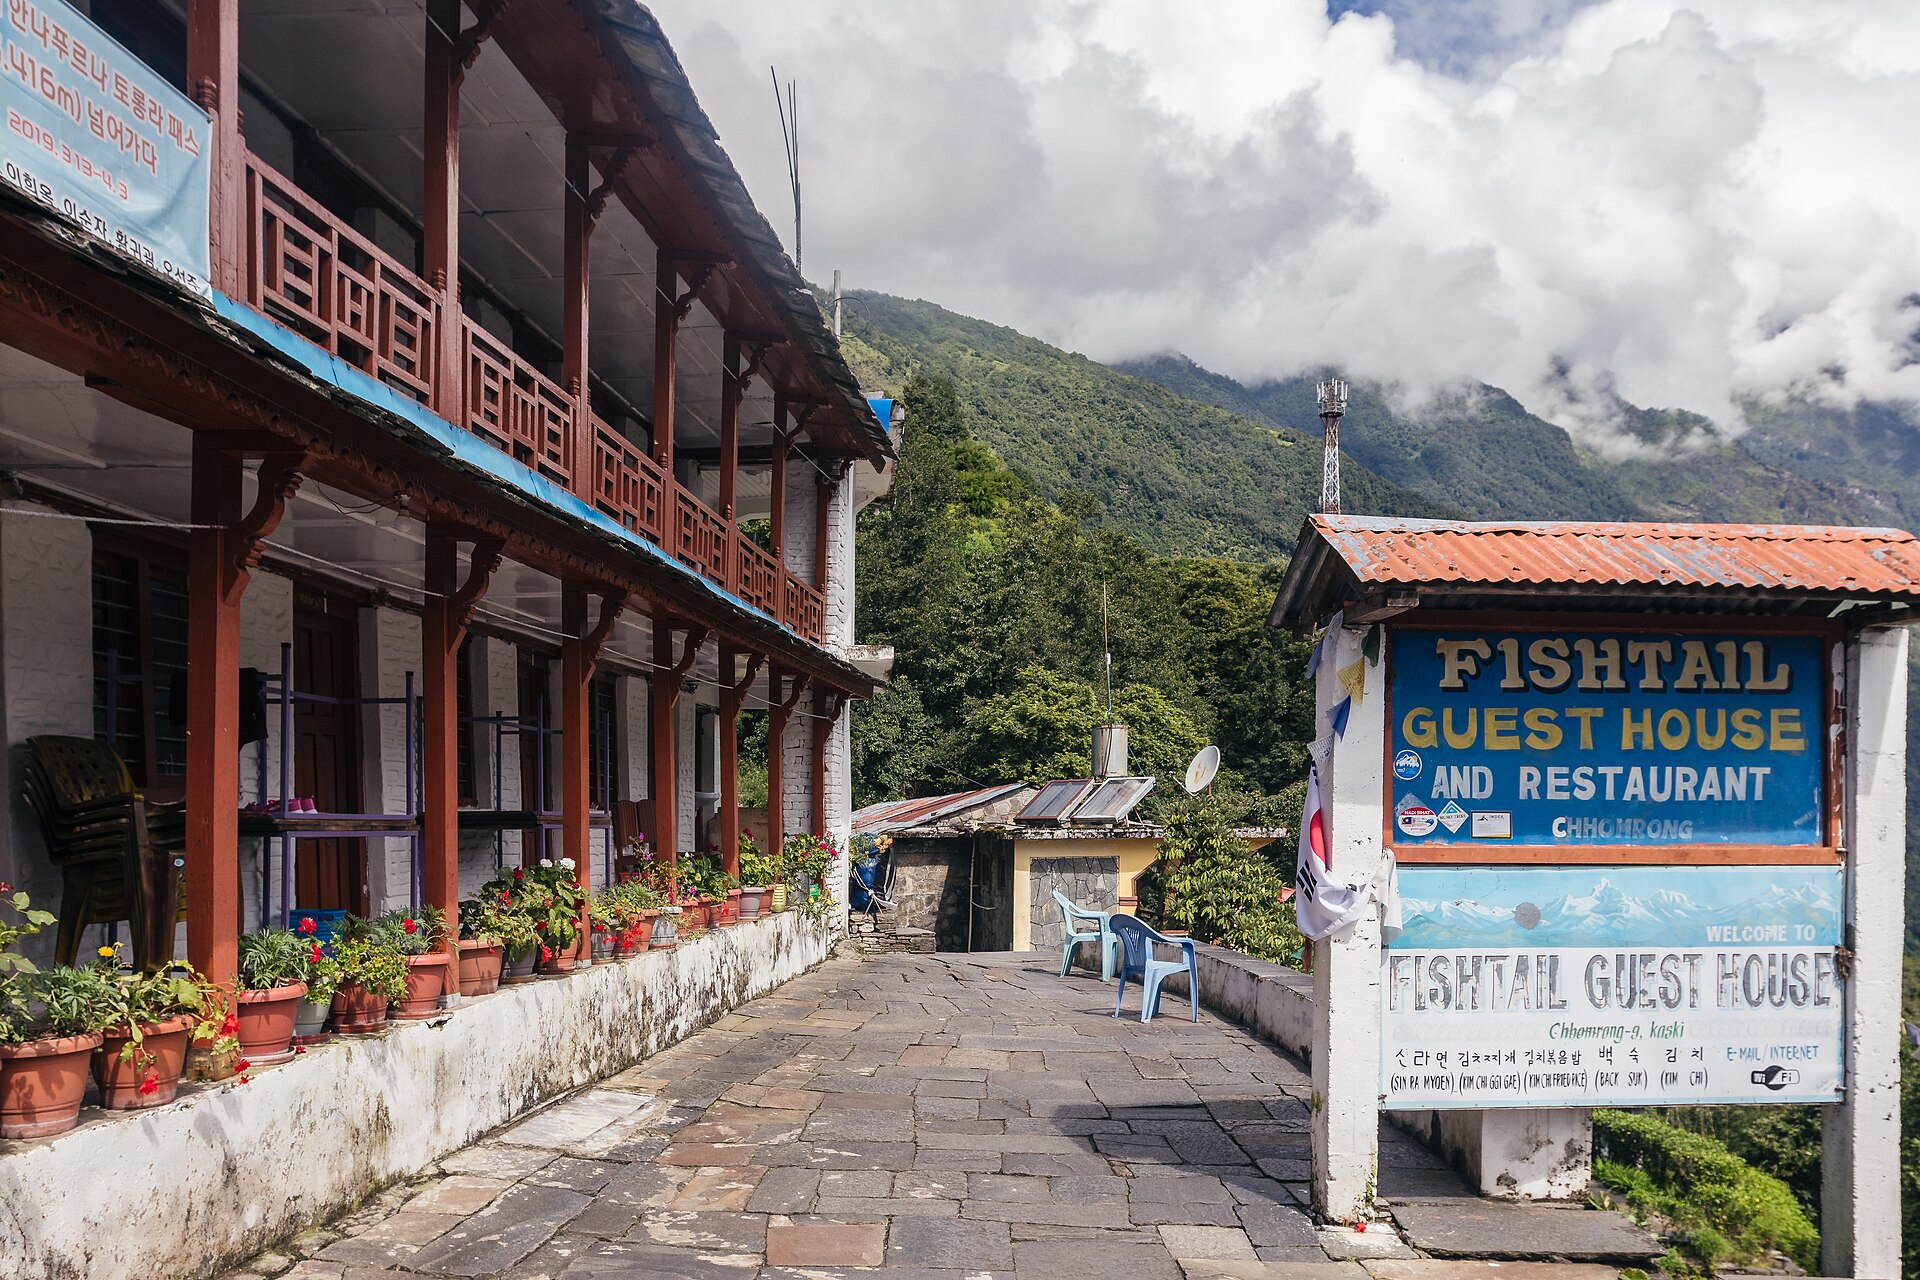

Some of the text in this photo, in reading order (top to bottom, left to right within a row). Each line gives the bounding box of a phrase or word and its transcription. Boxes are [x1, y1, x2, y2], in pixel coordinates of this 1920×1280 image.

[0, 43, 157, 174] .416m) 넘어가다
[113, 72, 163, 134] 토롱라
[168, 113, 198, 157] 패스
[1435, 638, 1792, 691] FISHTAIL
[1402, 707, 1805, 751] GUEST HOUSE
[1431, 766, 1771, 801] AND RESTAURANT
[1552, 817, 1694, 840] CHHOMRONG
[1706, 924, 1816, 942] WELCOME TO
[1389, 952, 1832, 1011] FISHTAIL GUEST HOUSE
